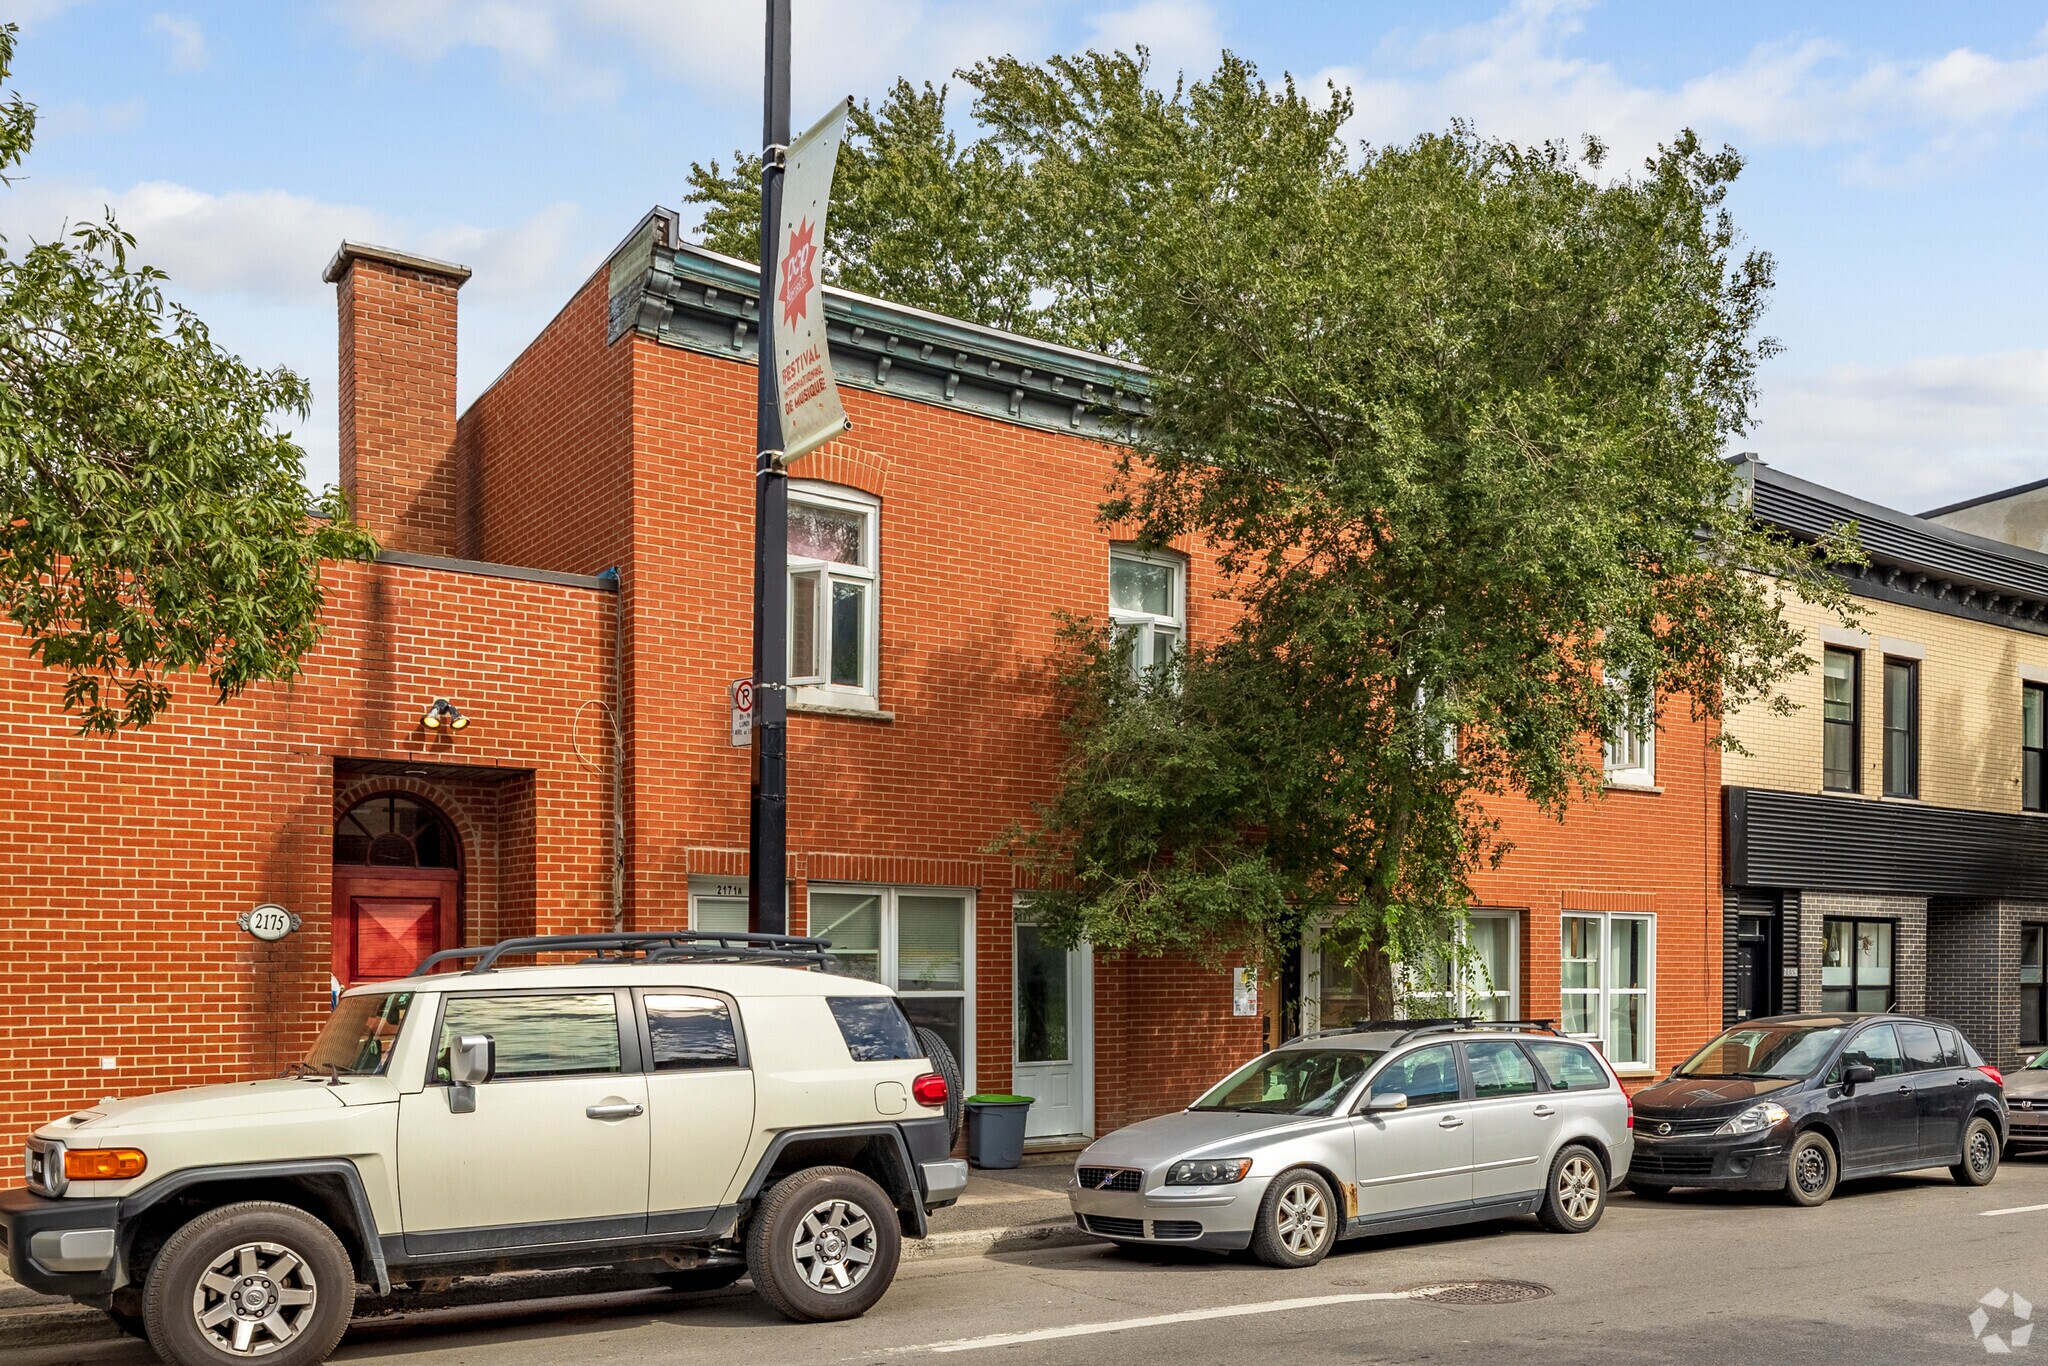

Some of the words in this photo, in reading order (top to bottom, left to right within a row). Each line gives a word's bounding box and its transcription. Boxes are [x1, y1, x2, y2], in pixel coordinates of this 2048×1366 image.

[782, 344, 820, 385] FESTIVAL
[785, 400, 794, 415] DE
[717, 885, 742, 895] 2171A
[255, 913, 284, 930] 2175
